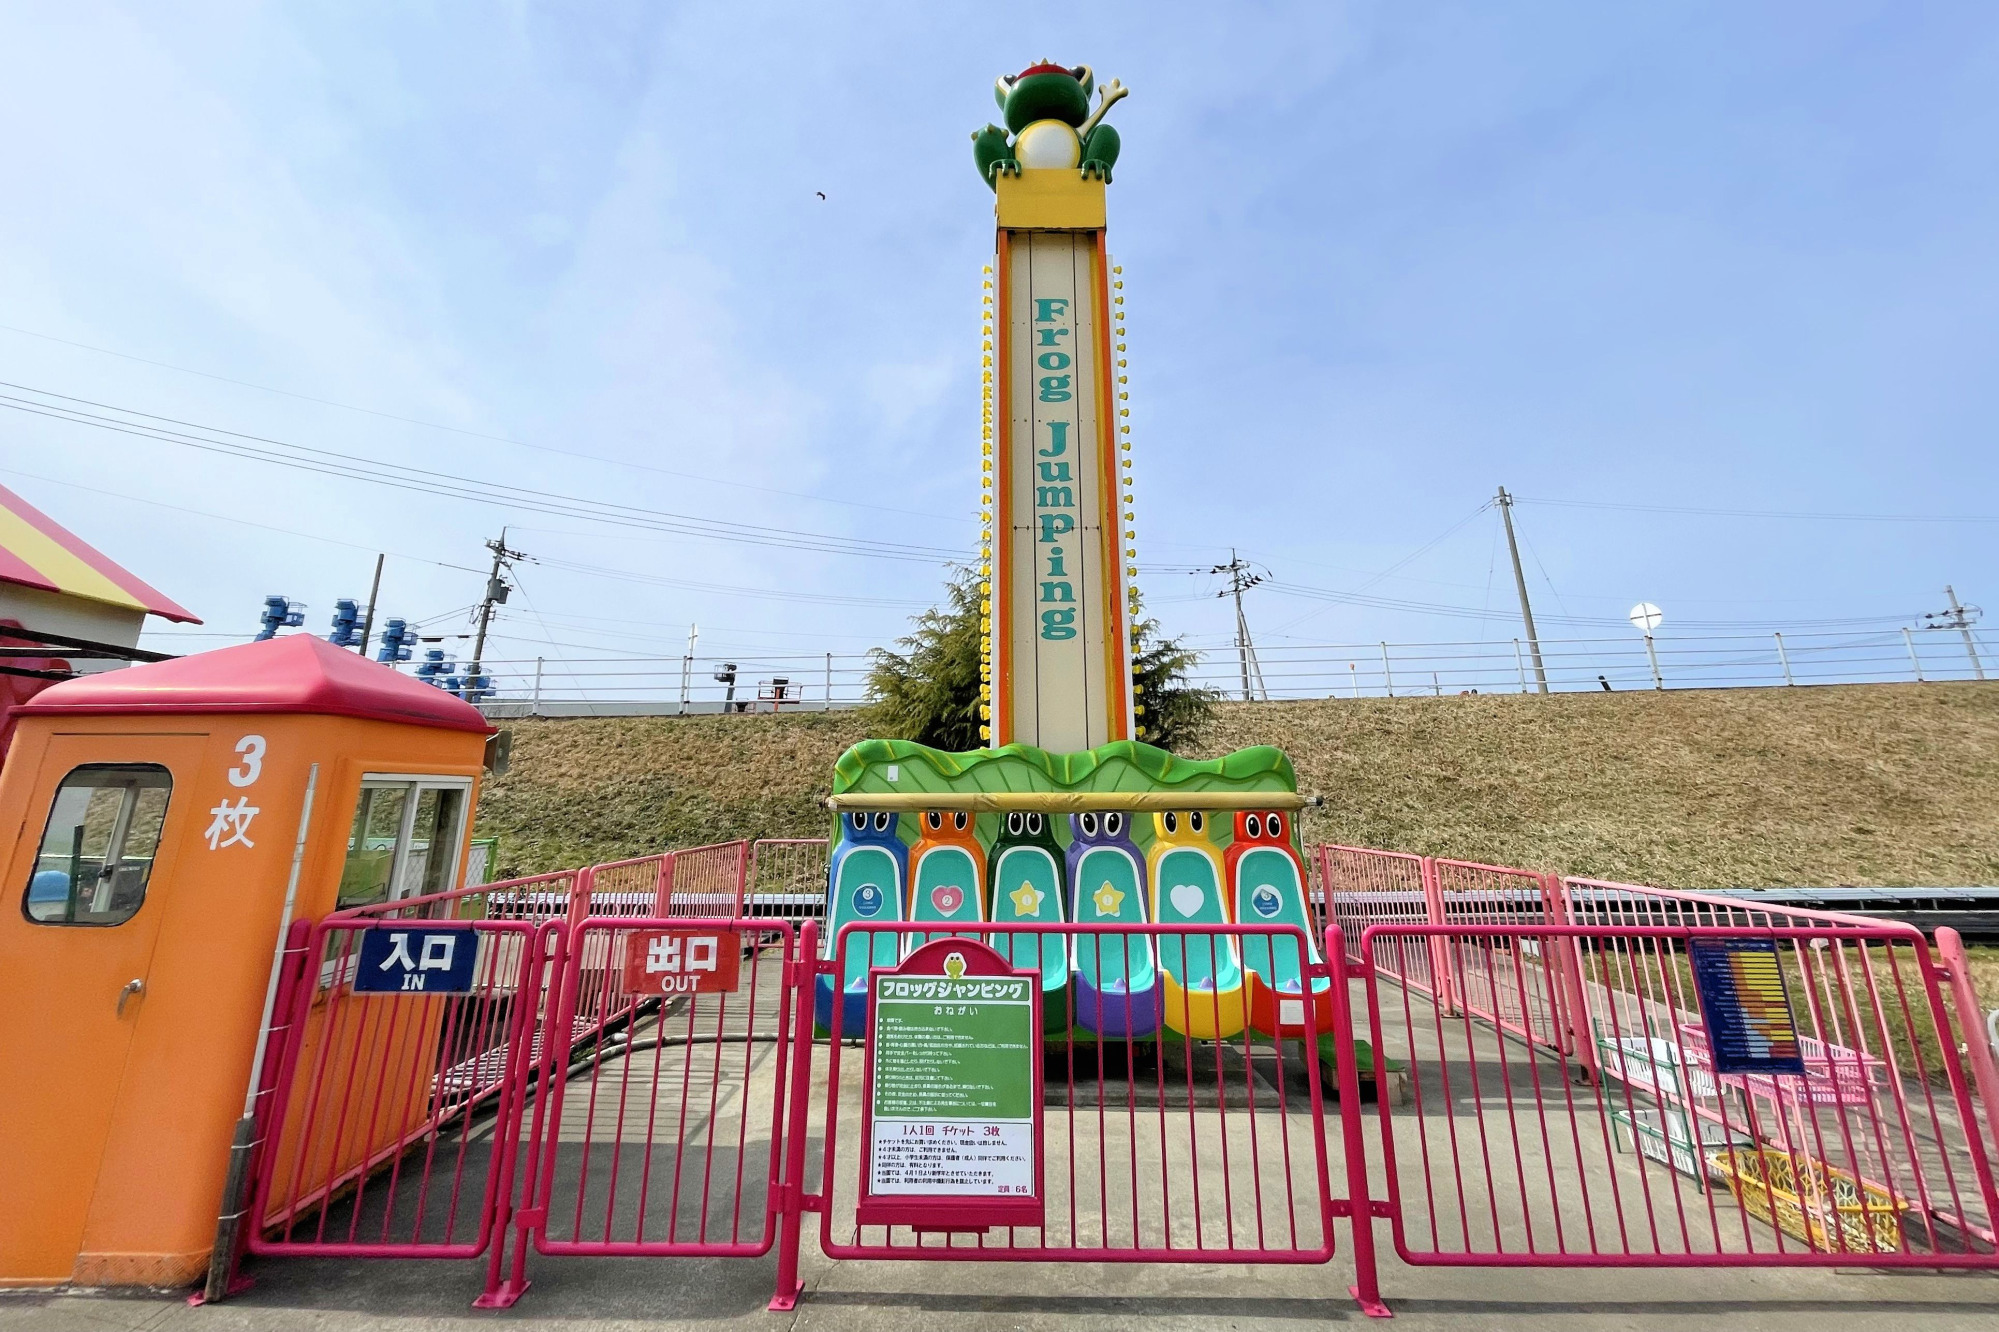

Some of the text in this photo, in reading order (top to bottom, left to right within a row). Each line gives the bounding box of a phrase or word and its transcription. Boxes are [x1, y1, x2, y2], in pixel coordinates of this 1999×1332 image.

[1034, 298, 1077, 641] Frog Jumping
[379, 933, 455, 971] 入口
[646, 936, 718, 973] 出口
[401, 974, 425, 991] IN
[661, 975, 701, 992] OUT
[883, 981, 1024, 999] フロッグジャンピング
[934, 1006, 978, 1016] おねがい
[942, 1126, 974, 1136] チケット
[983, 1126, 1000, 1136] 3枚
